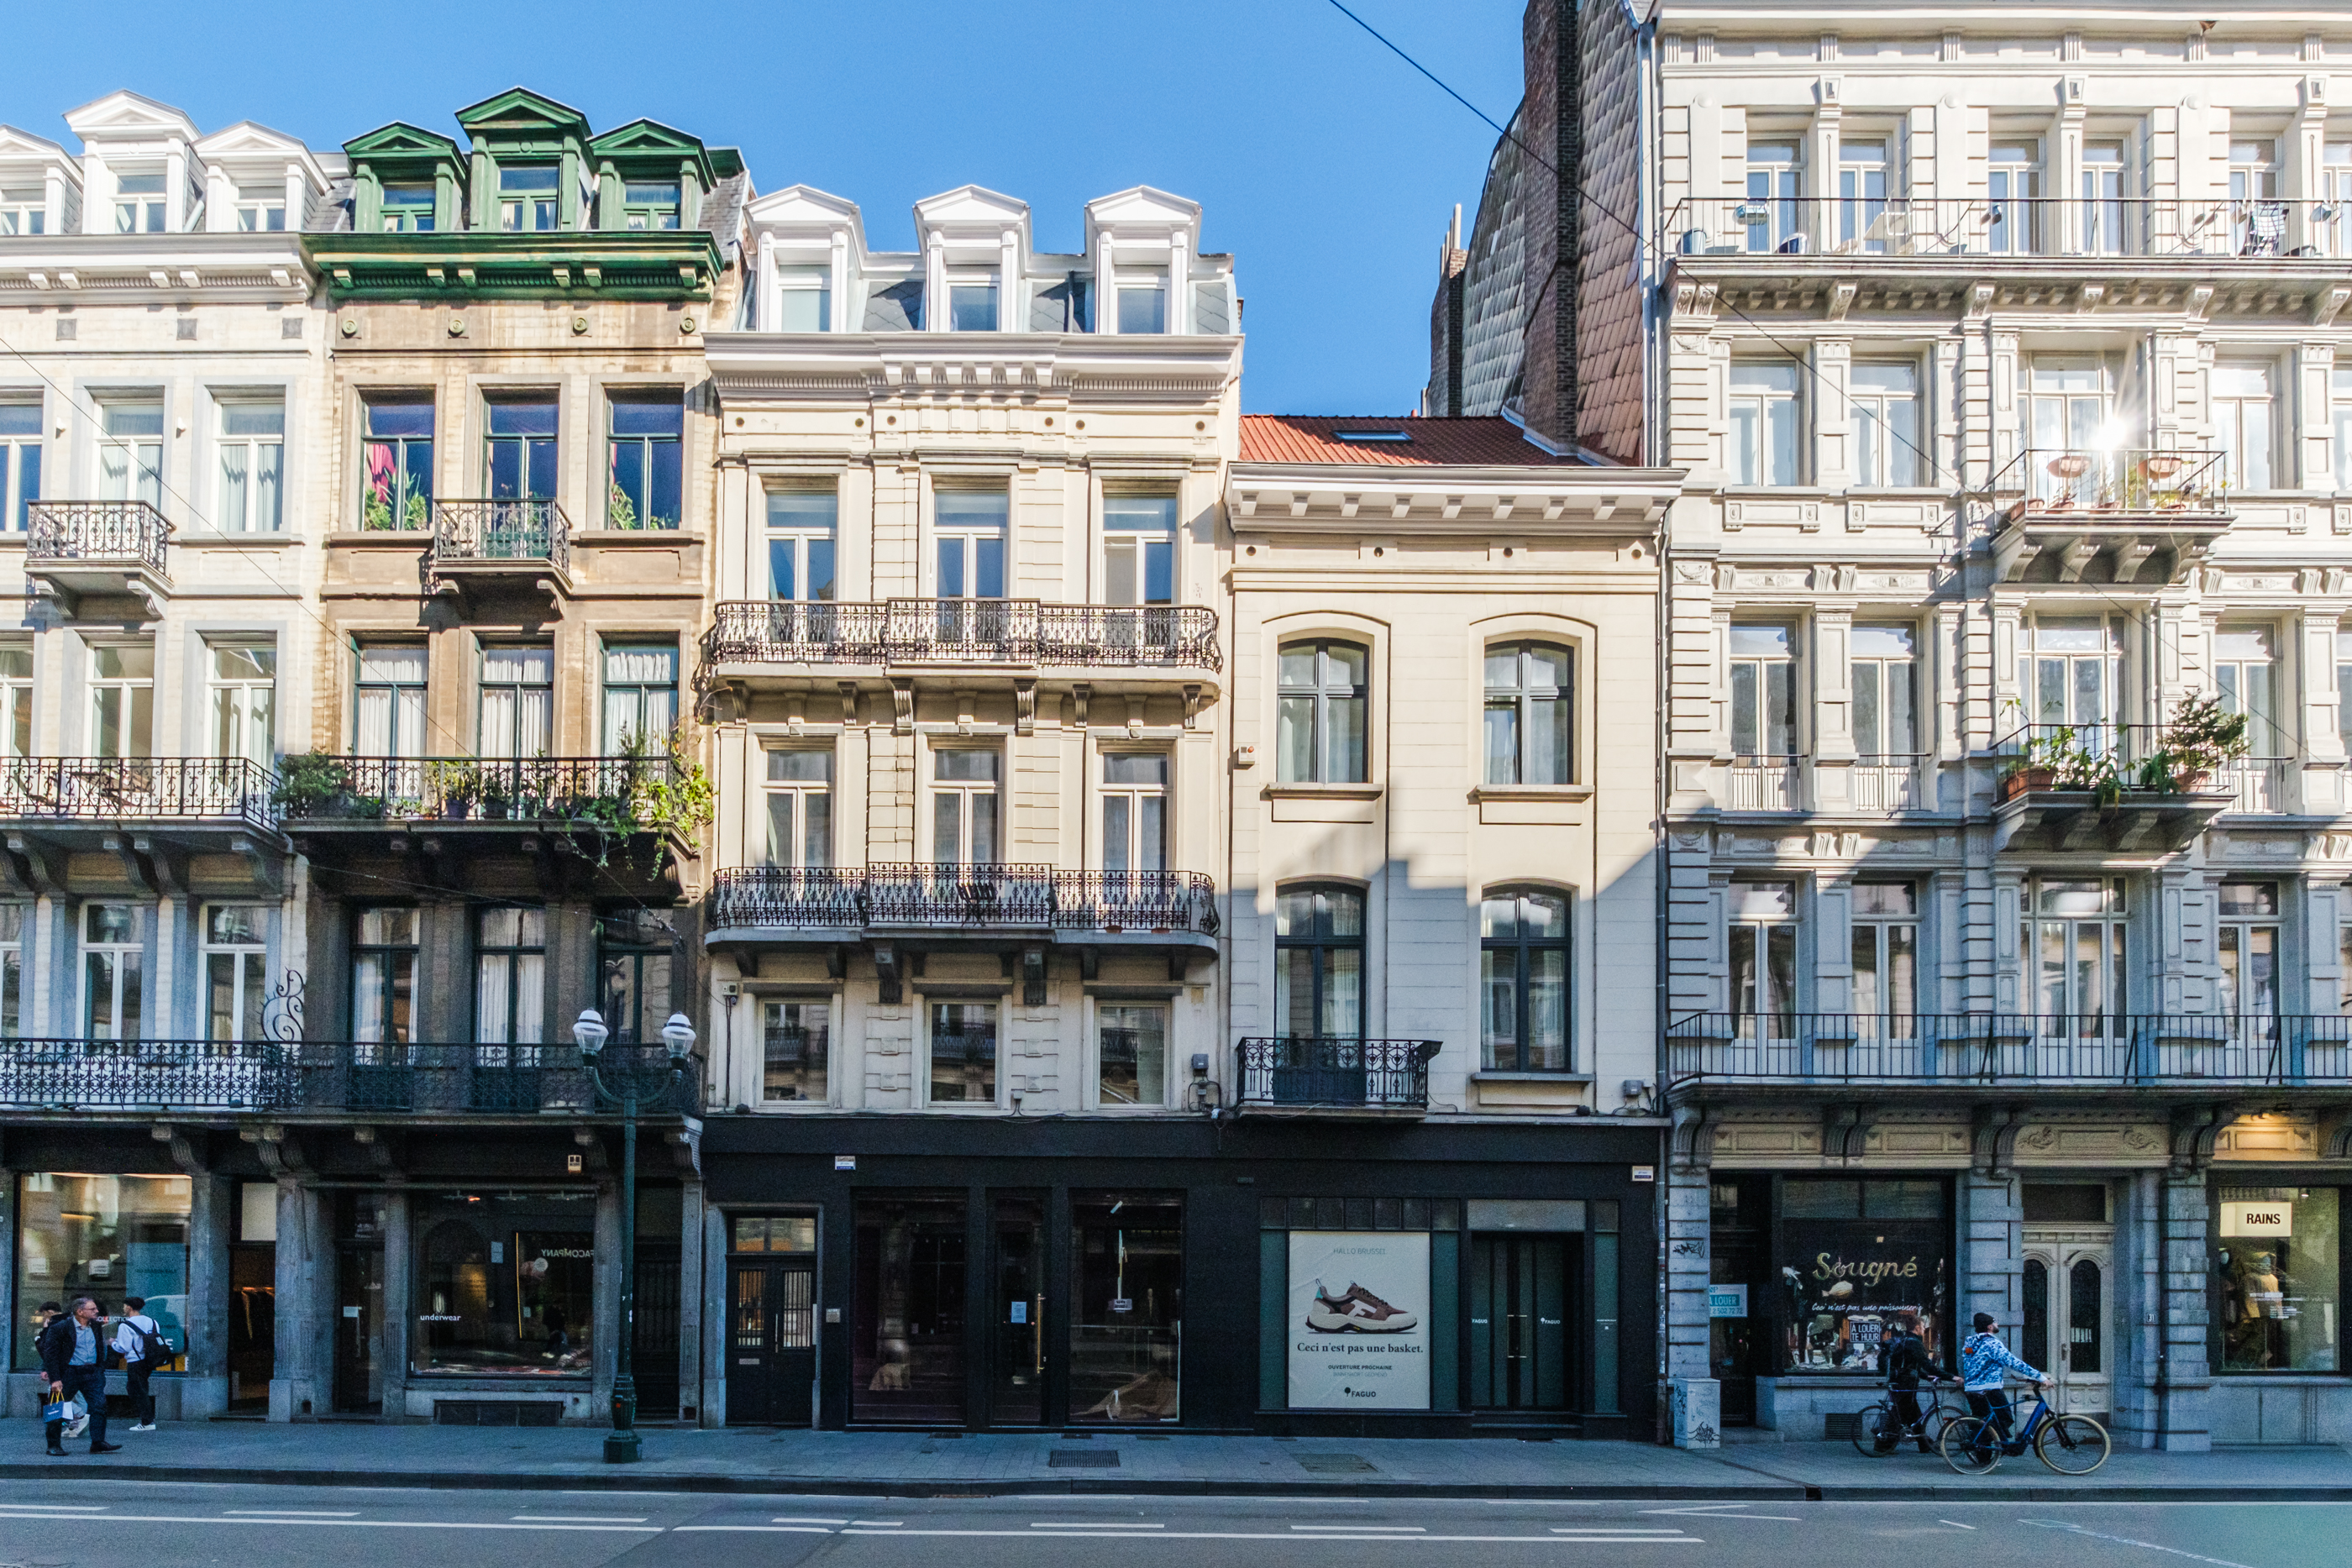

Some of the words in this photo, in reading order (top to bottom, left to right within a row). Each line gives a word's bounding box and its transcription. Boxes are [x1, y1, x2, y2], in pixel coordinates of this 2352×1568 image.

[2246, 1213, 2281, 1225] RAINS
[1812, 1252, 1918, 1287] Sougné
[1714, 1296, 1736, 1306] LOUER
[1858, 1324, 1879, 1333] LOUER
[1851, 1333, 1859, 1341] TE
[1861, 1333, 1879, 1341] HUUR
[1297, 1343, 1319, 1352] Ceci
[1322, 1343, 1345, 1352] n'est
[1347, 1345, 1364, 1354] pas
[1388, 1344, 1424, 1353] basket.
